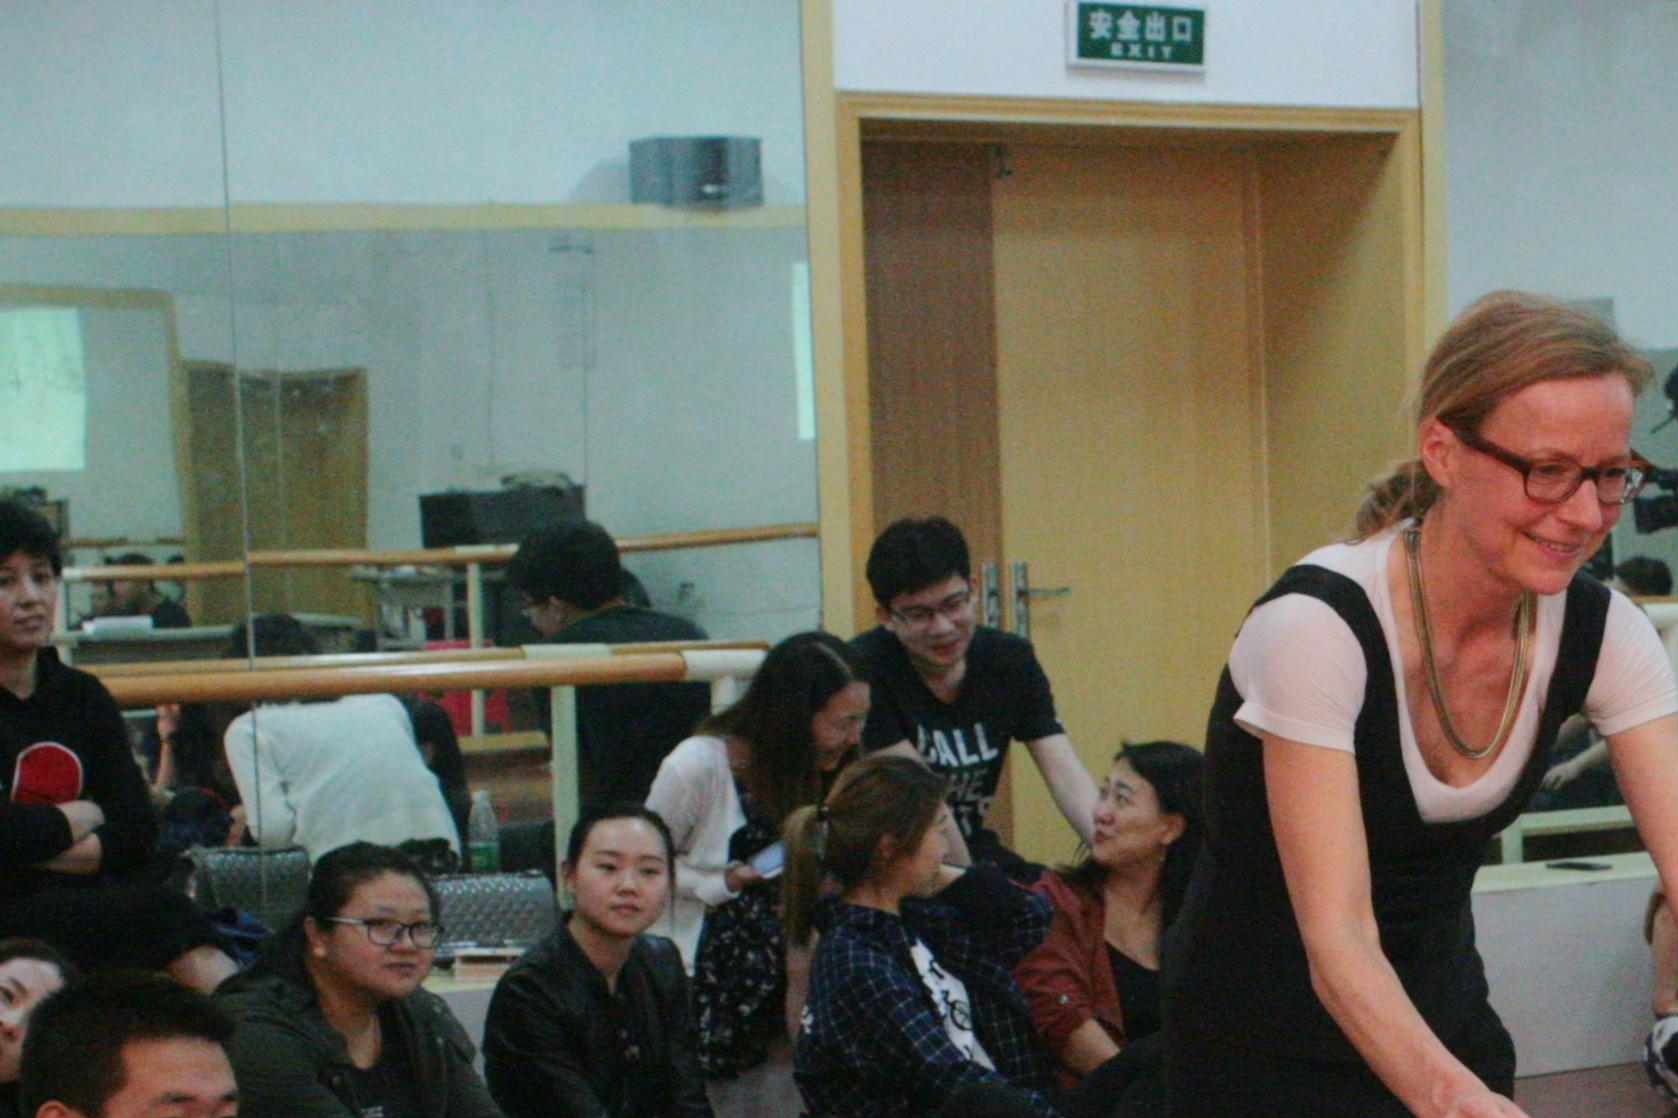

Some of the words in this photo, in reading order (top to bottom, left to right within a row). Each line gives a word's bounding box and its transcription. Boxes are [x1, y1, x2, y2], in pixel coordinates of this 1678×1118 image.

[1088, 9, 1192, 42] 安全出口
[1110, 42, 1172, 59] EXIT
